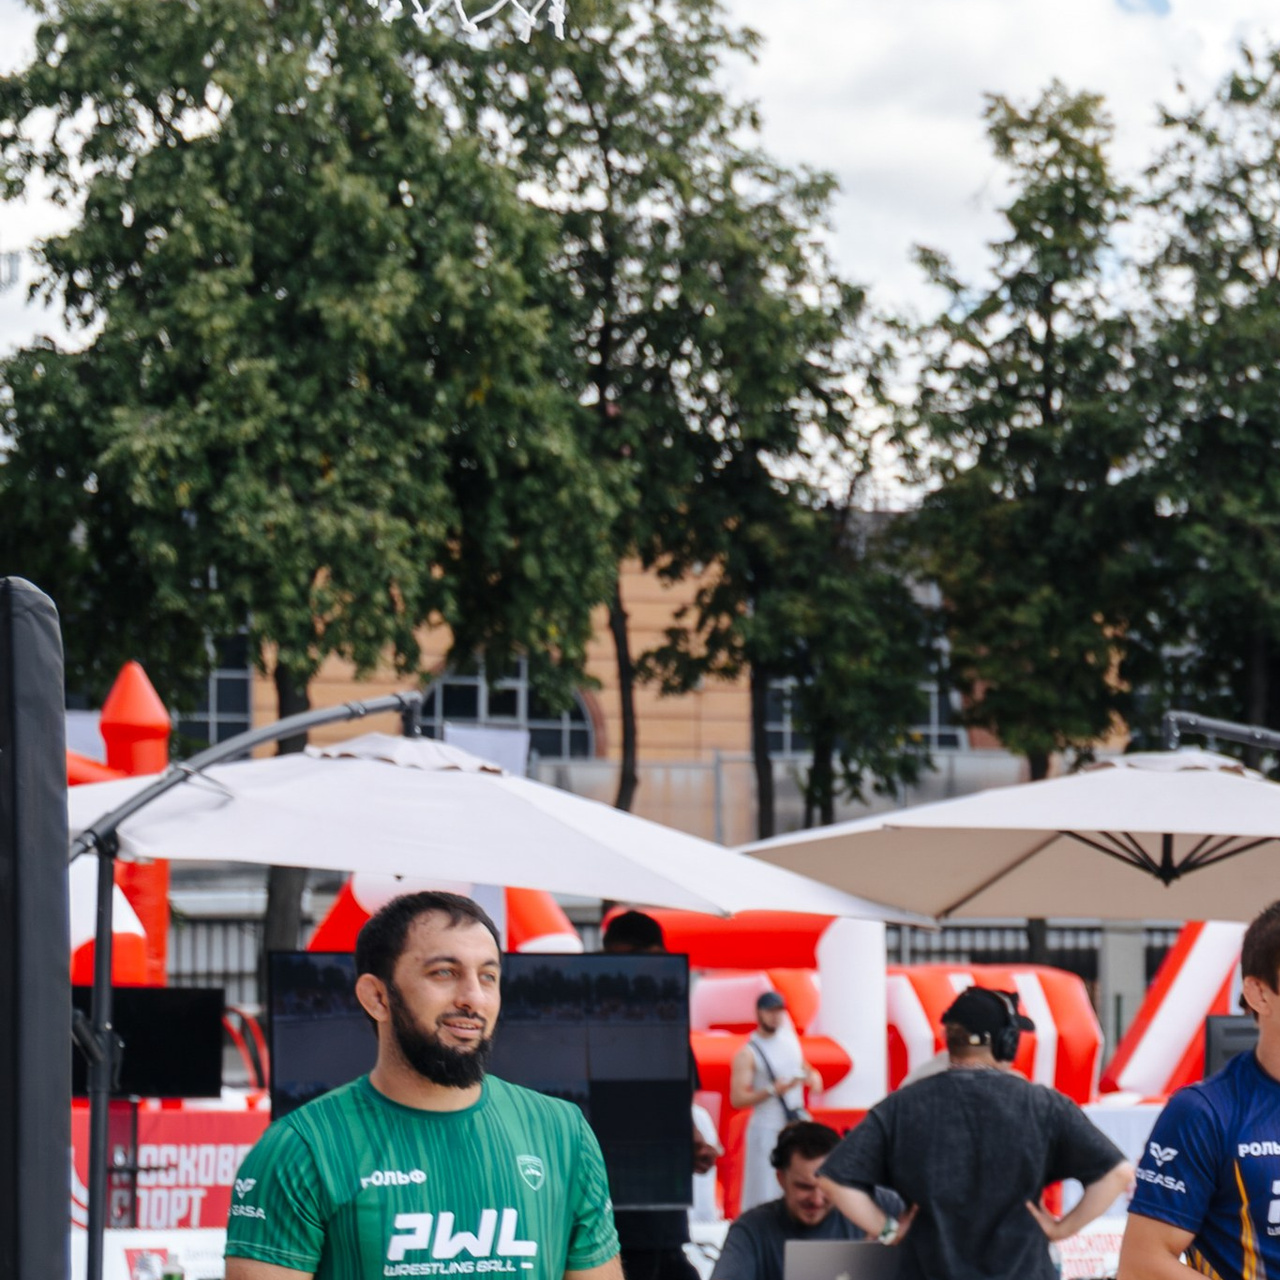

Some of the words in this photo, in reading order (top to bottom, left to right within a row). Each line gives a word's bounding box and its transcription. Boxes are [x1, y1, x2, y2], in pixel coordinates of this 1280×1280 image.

[387, 1208, 538, 1261] PWL
[383, 1260, 475, 1277] WRESTLING
[476, 1259, 516, 1273] BALL
